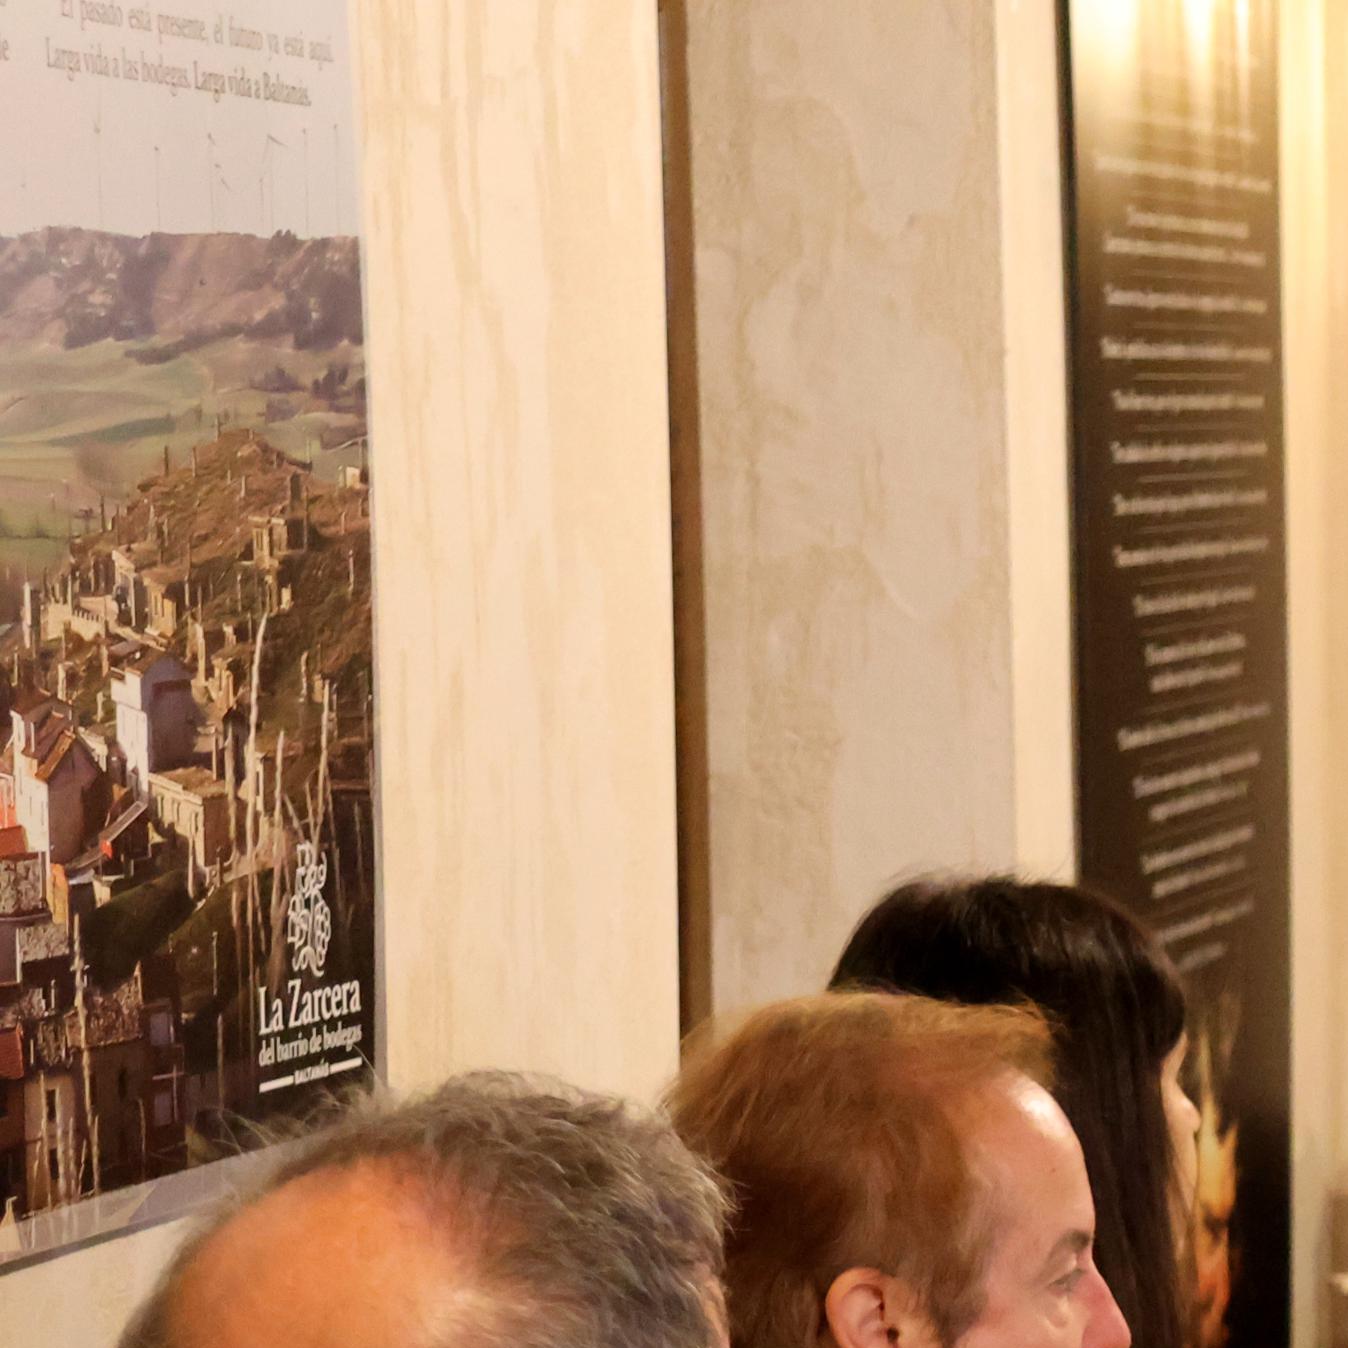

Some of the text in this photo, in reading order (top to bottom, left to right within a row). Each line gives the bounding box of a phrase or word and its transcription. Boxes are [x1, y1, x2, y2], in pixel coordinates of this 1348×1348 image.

[46, 36, 81, 82] Larga
[193, 60, 225, 103] Larga
[227, 66, 252, 98] vida
[259, 979, 362, 1036] La Zarcera
[258, 1021, 362, 1067] del barrio de bodegas
